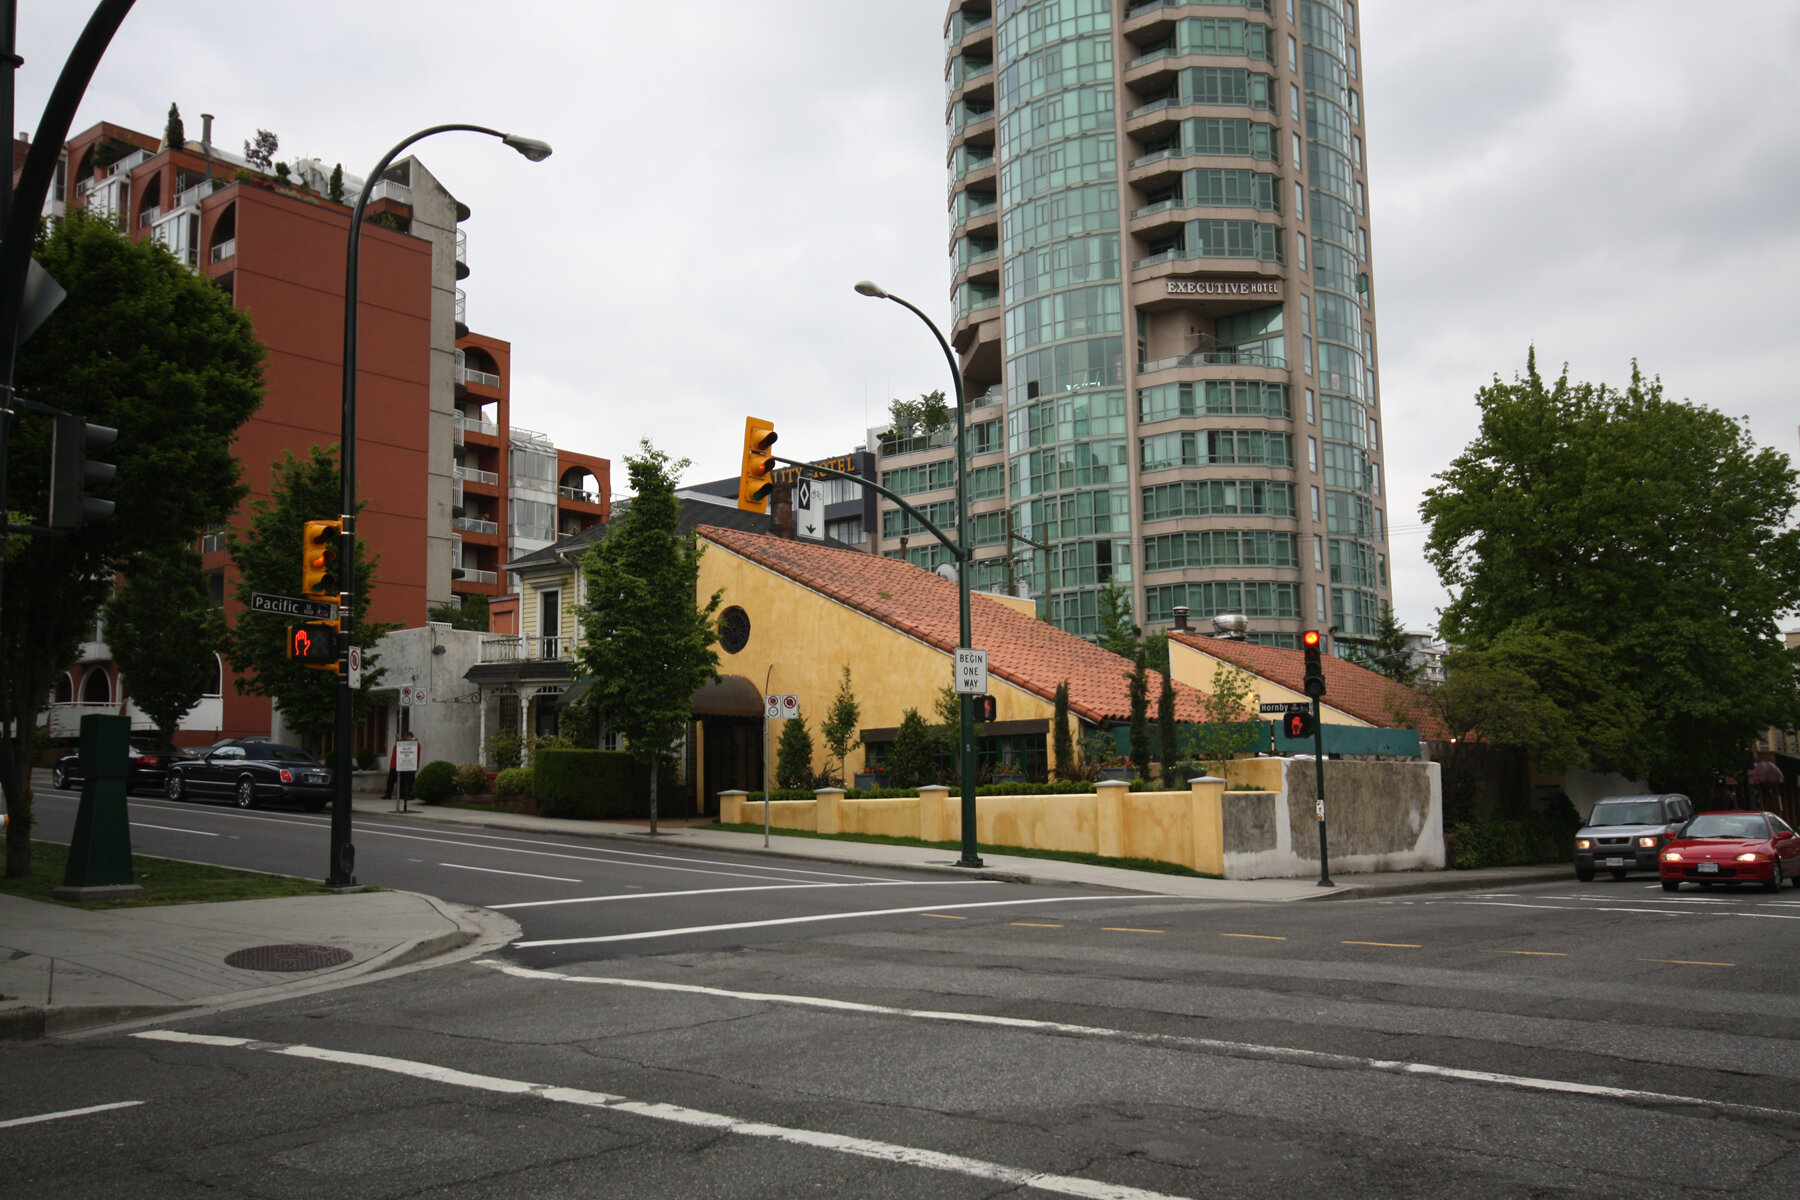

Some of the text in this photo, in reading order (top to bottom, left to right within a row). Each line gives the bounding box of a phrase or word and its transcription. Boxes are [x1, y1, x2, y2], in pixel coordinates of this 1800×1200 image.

[1167, 281, 1278, 294] EXECUTIVE HOTEL
[255, 596, 299, 613] Pacific
[959, 654, 983, 663] BEGIN
[963, 666, 979, 676] ONE
[963, 679, 978, 688] WAY
[1261, 704, 1289, 712] Hornby
